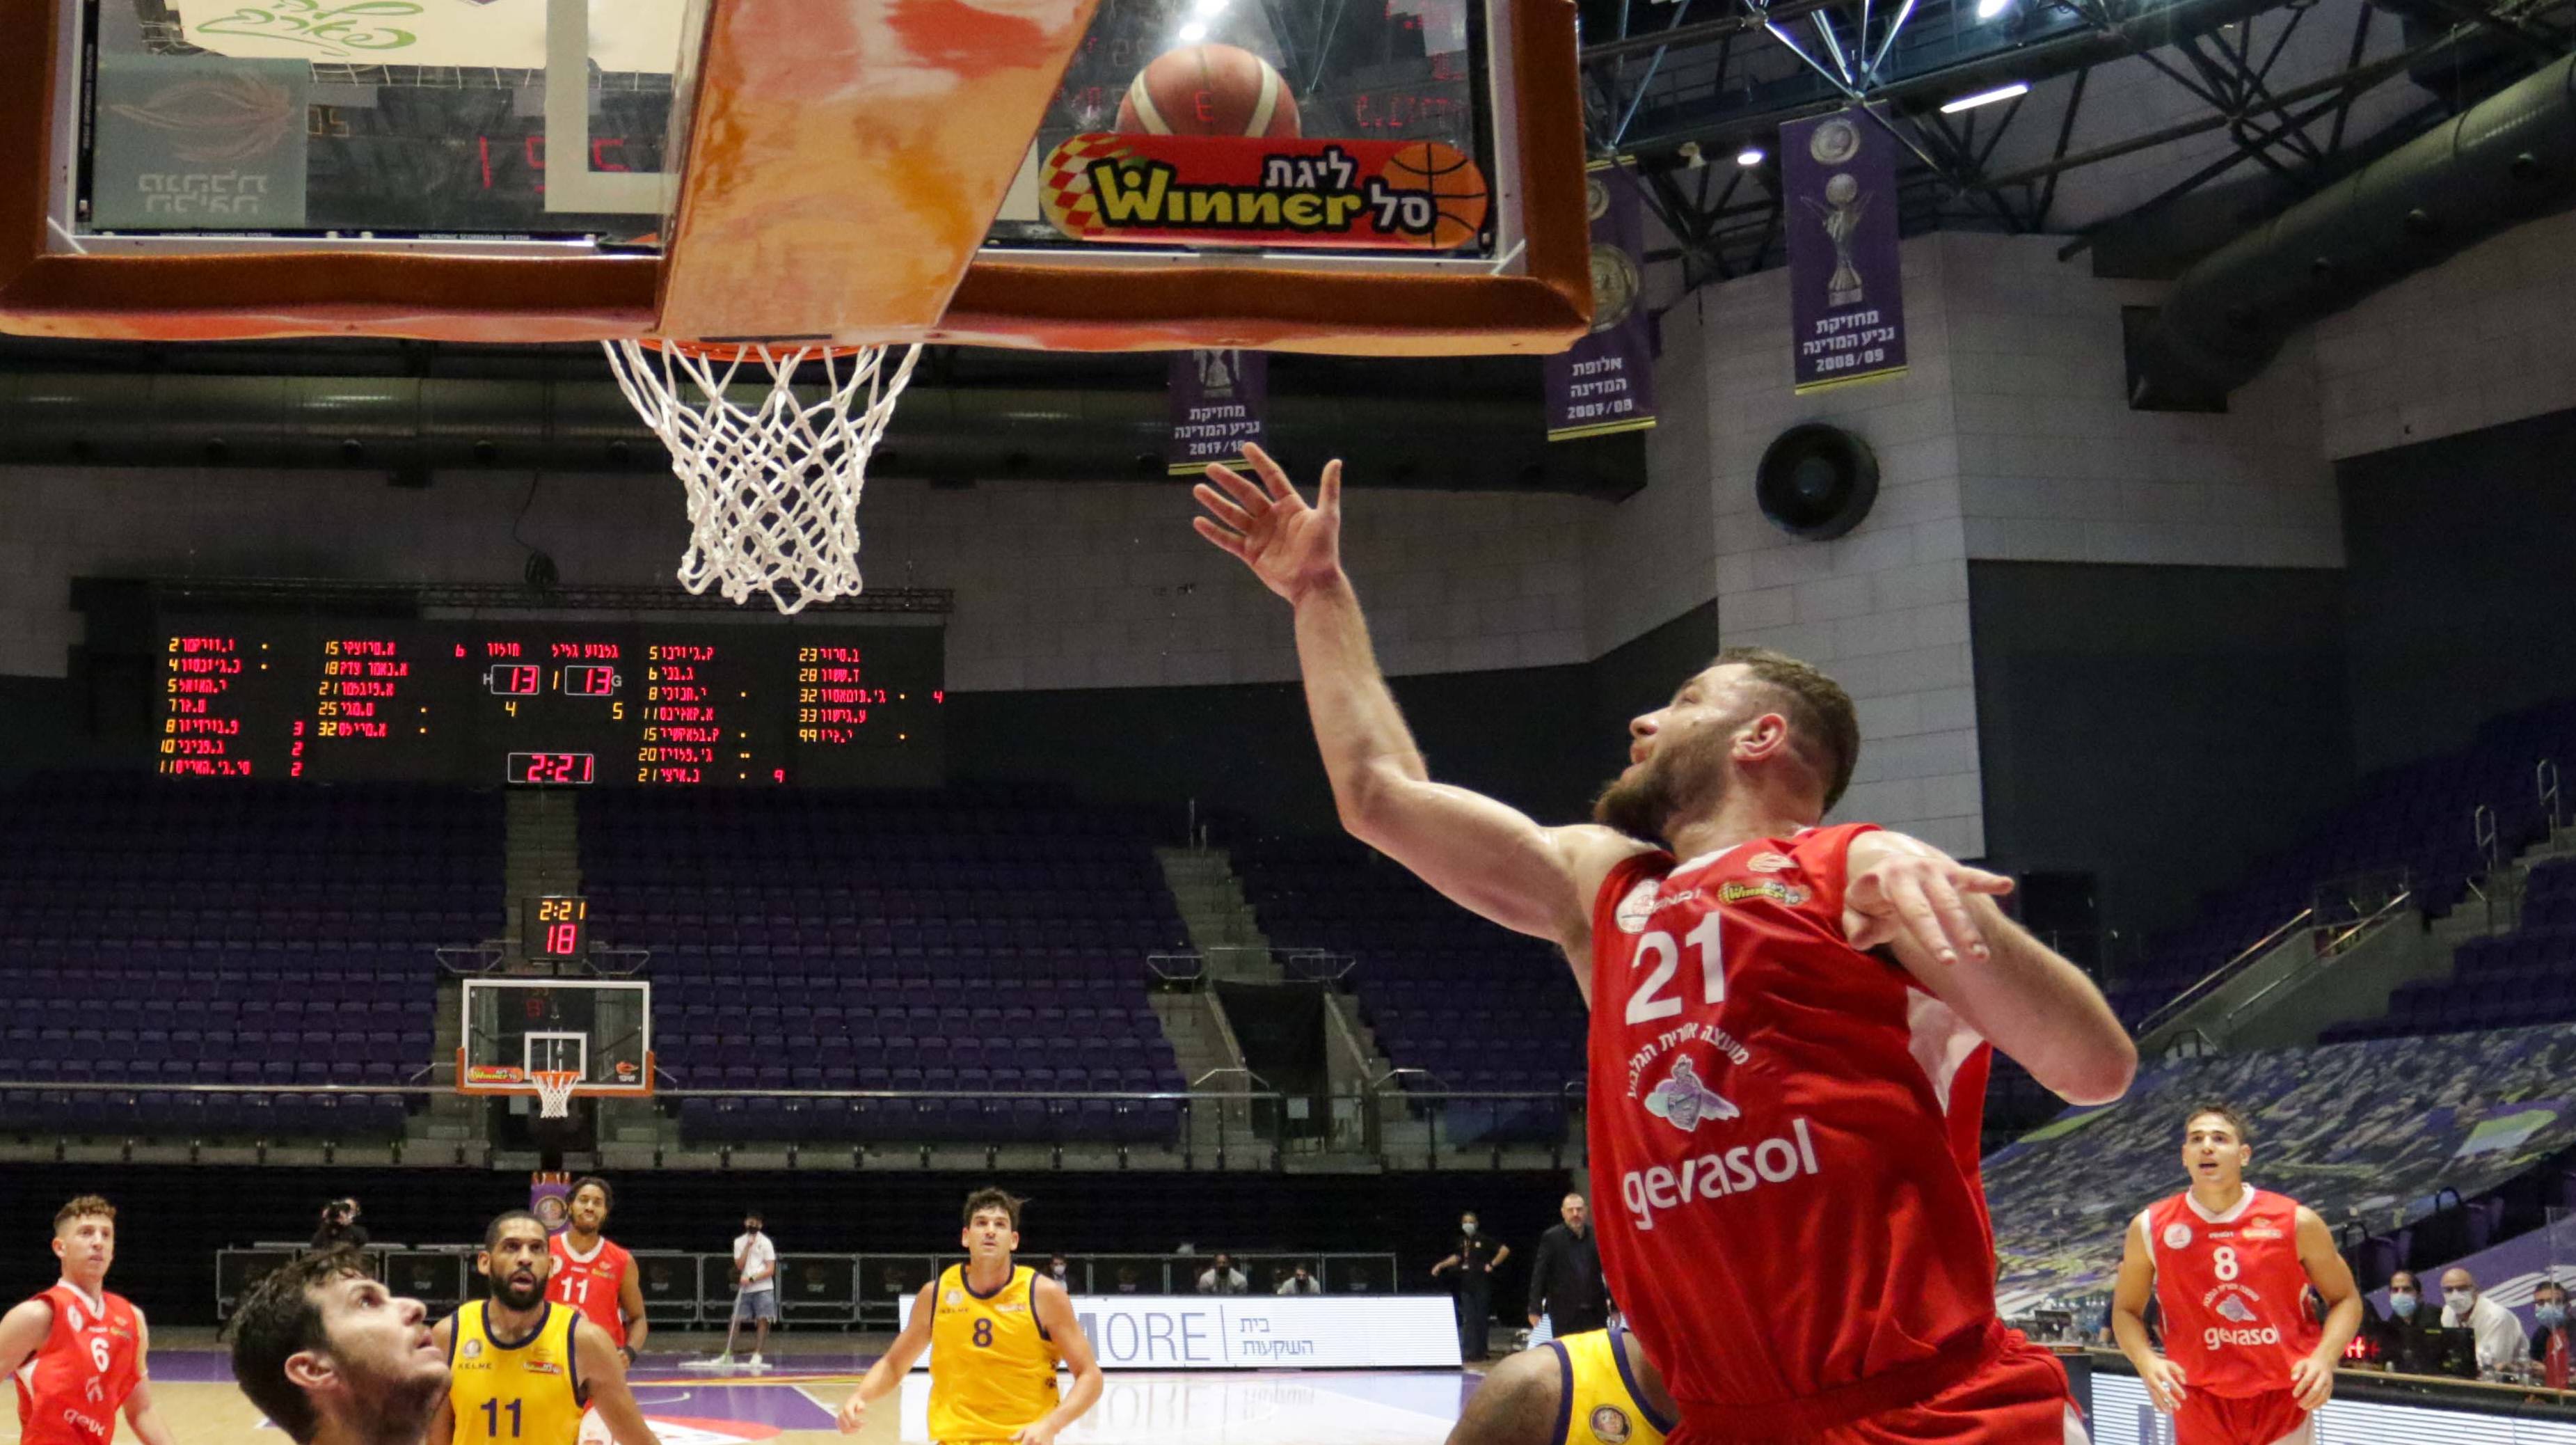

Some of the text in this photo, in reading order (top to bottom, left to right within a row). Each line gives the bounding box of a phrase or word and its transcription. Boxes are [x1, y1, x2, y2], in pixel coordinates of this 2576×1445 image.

[1266, 150, 1352, 189] ליגת
[1094, 164, 1362, 226] Winner
[1370, 184, 1431, 228] סל
[1815, 310, 1879, 334] מחזיקת
[1803, 326, 1895, 356] גביע המדינה
[1573, 356, 1622, 377] אלופת
[1816, 349, 1884, 372] 2008/09
[1571, 378, 1627, 397] המדינה
[1189, 405, 1246, 423] מחזיקת
[1568, 398, 1633, 419] 2007/08
[1175, 421, 1260, 439] גביע המדינה
[168, 637, 180, 652] 2
[325, 641, 340, 655] 15
[585, 644, 620, 658] גלבוע
[649, 645, 658, 660] 5
[800, 648, 818, 662] 23
[168, 658, 179, 672] 4
[324, 661, 339, 675] 18
[483, 666, 538, 693] H 13
[649, 667, 658, 680] 6
[800, 668, 818, 682] 28
[167, 678, 177, 693] 5
[319, 681, 339, 695] 21
[585, 668, 621, 695] 13 G
[649, 686, 658, 700] 8
[800, 688, 818, 702] 32
[932, 690, 944, 704] 4
[168, 699, 177, 712] 7
[318, 702, 337, 716] 25
[505, 701, 517, 717] 4
[612, 702, 623, 720] 5
[644, 707, 658, 720] 11
[800, 709, 818, 722] 33
[165, 718, 176, 733] 8
[292, 720, 304, 736] 3
[317, 722, 337, 736] 32
[644, 727, 657, 741] 15
[799, 729, 818, 743] 99
[161, 739, 175, 753] 10
[291, 741, 304, 756] 2
[638, 748, 658, 761] 20
[160, 759, 174, 774] 11
[291, 761, 303, 776] 2
[527, 755, 591, 782] 2:21
[638, 768, 657, 782] 21
[773, 769, 786, 784] 9
[539, 901, 586, 921] 2:21
[547, 924, 576, 954] 18
[1625, 910, 1725, 1026] 21
[1623, 1118, 1819, 1231] gevasol
[2213, 1245, 2239, 1281] 8
[560, 1276, 589, 1304] 11
[1240, 1317, 1271, 1333] בית
[972, 1318, 993, 1348] 8
[90, 1337, 110, 1373] 6
[1243, 1340, 1314, 1361] השקעות
[480, 1398, 521, 1437] 11
